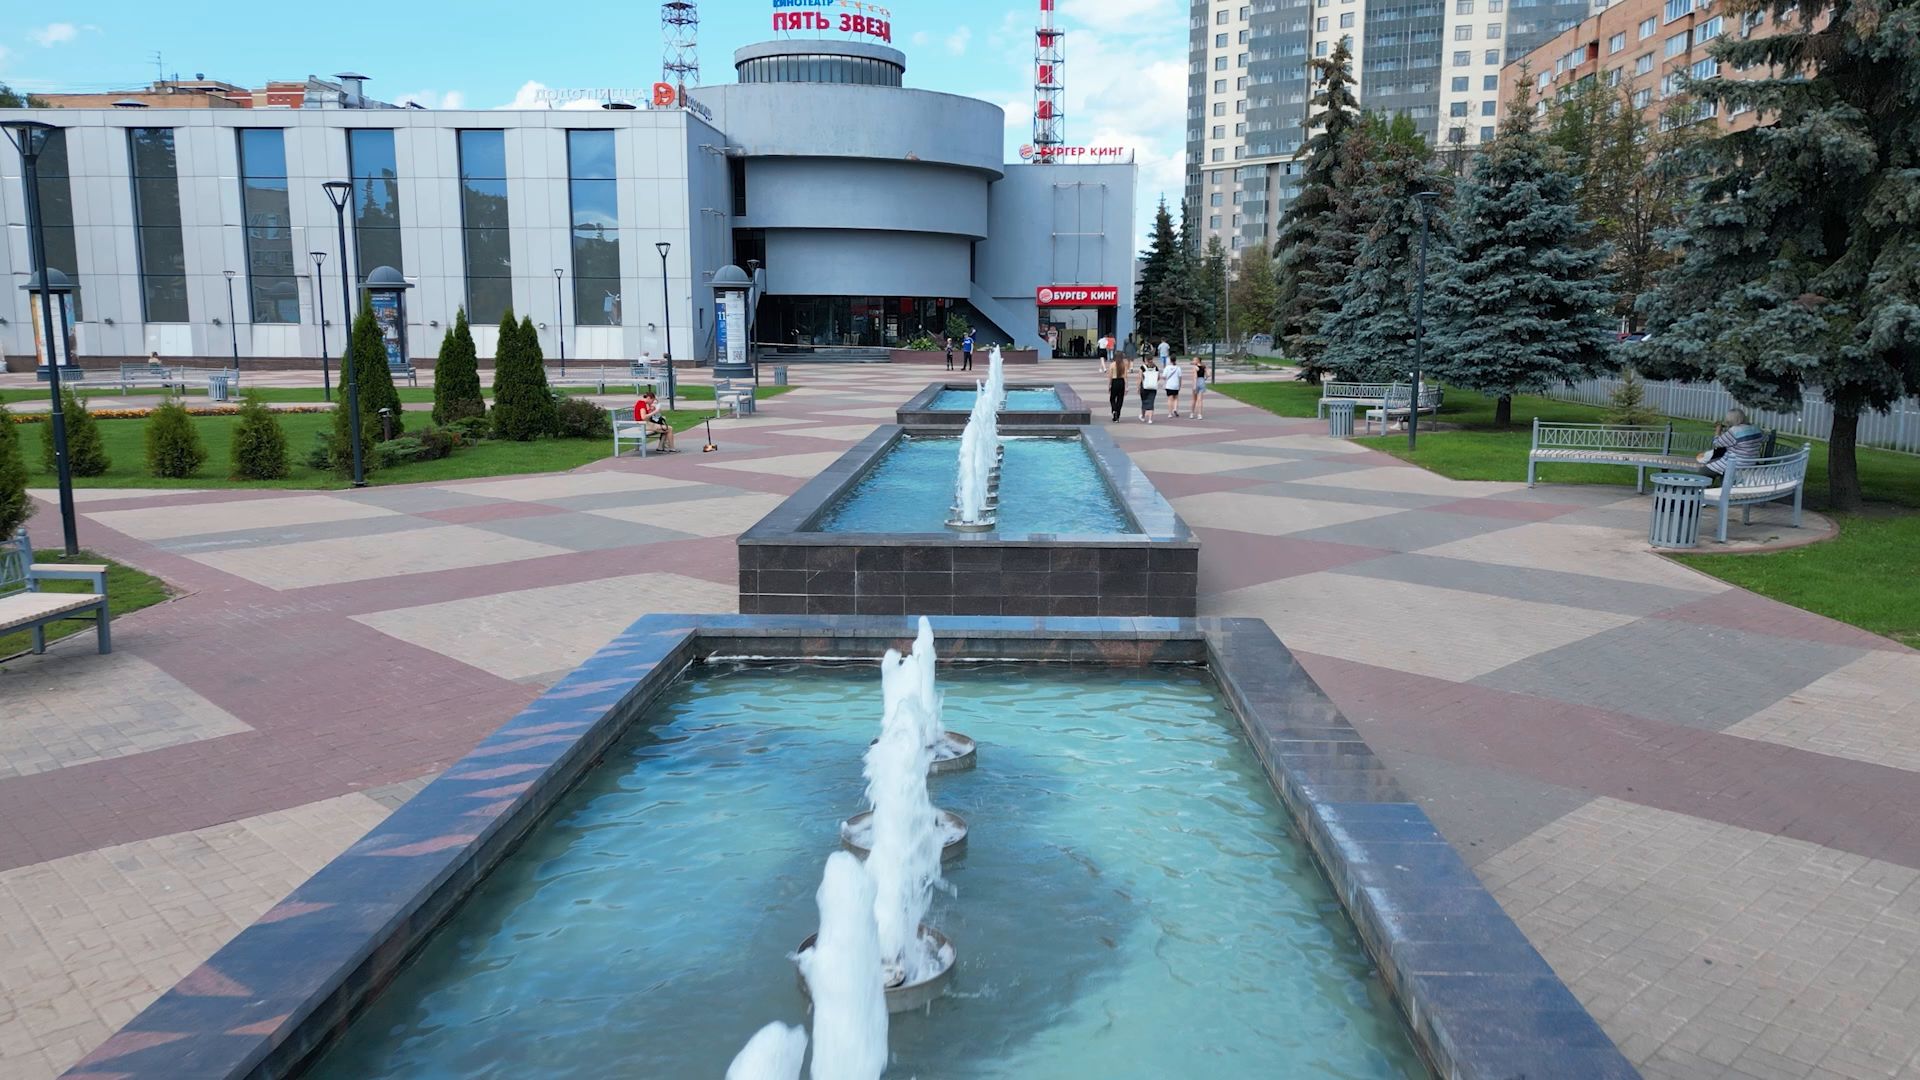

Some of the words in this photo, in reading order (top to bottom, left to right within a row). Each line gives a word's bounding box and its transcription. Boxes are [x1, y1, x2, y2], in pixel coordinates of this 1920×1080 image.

[773, 12, 830, 31] ПЯТЬ
[839, 13, 891, 43] ЗВЕЗД
[1040, 147, 1086, 156] БУРГЕР
[1090, 147, 1124, 156] КИНГ
[1053, 291, 1088, 300] БУРГЕР
[1090, 291, 1116, 300] КИНГ
